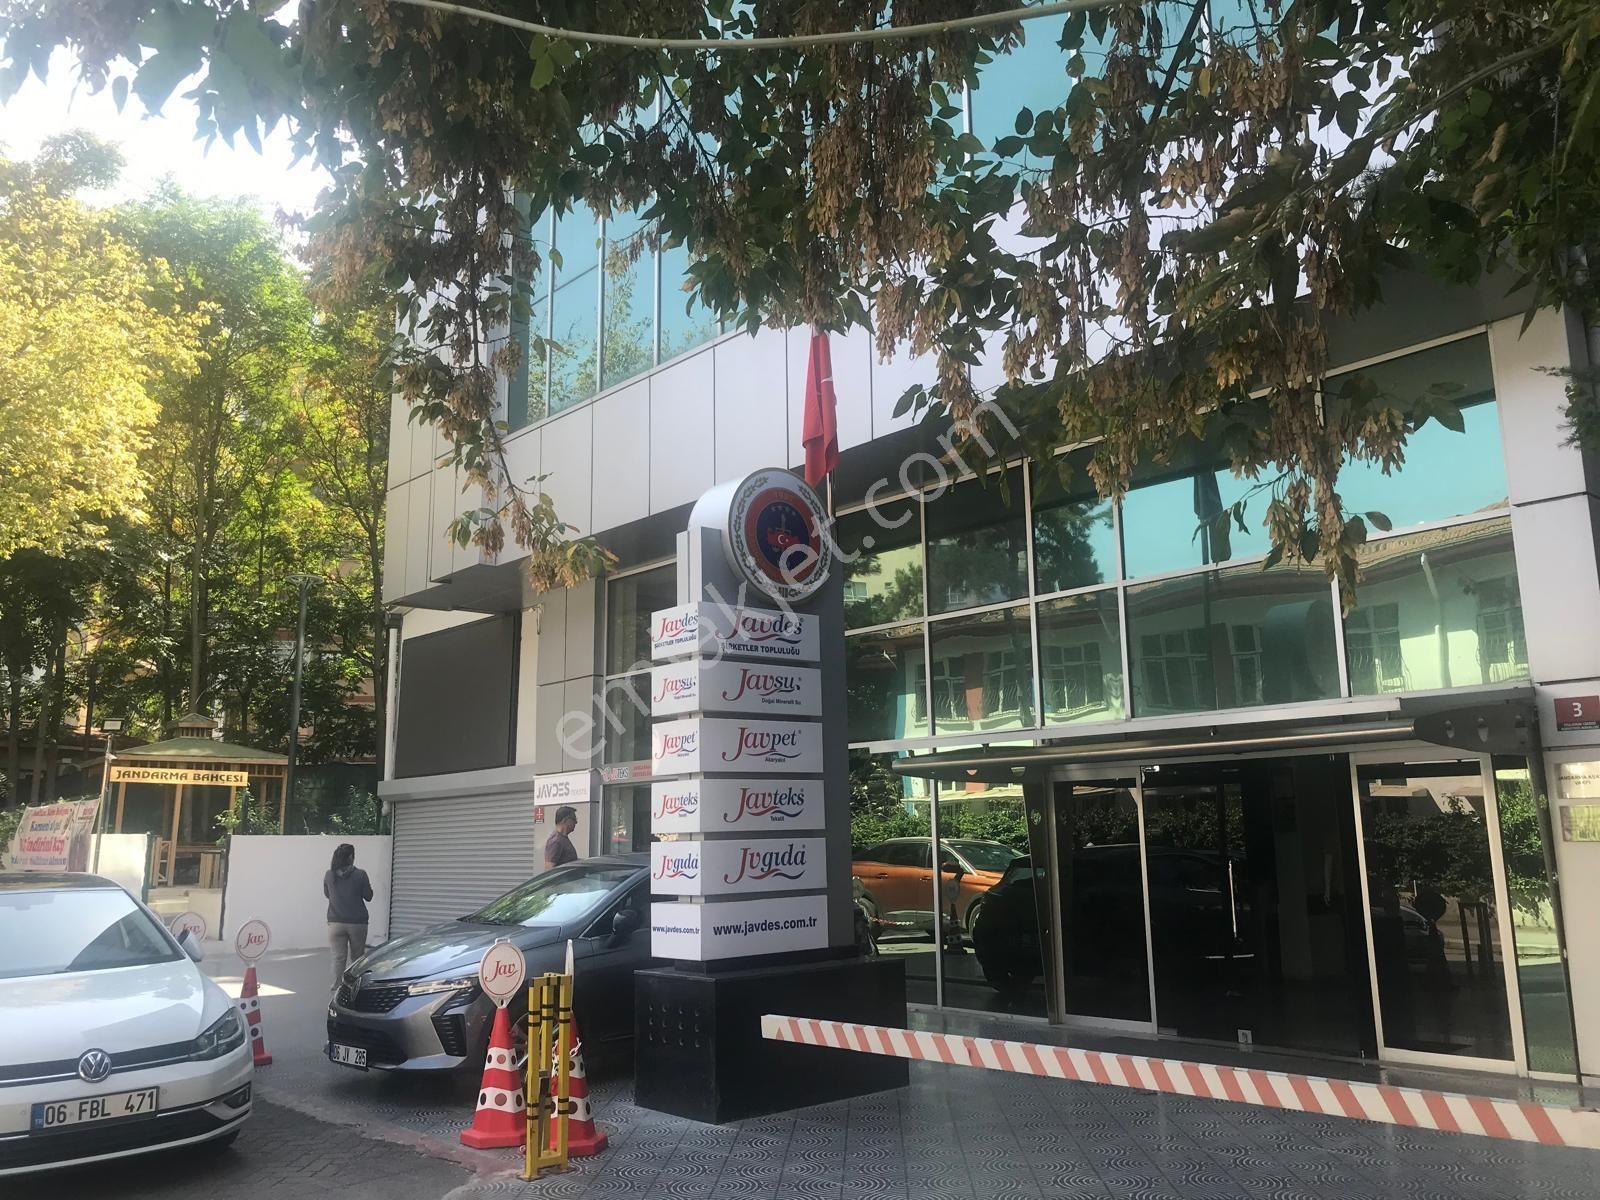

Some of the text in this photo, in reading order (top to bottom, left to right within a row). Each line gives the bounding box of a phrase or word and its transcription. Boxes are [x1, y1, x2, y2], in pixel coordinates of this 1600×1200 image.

[652, 612, 698, 642] Javdes
[715, 609, 802, 640] Javdes
[761, 645, 800, 656] TOPLULUĞU
[722, 668, 795, 701] Javsu
[1572, 702, 1583, 717] 3
[655, 732, 695, 759] Javpet
[722, 727, 797, 761] Javpet
[116, 770, 188, 780] JANDARMA
[537, 782, 570, 799] JAVDES
[653, 792, 698, 819] Javteks
[723, 787, 804, 823] Javteks
[652, 925, 700, 934] www.javdes.com.tr
[713, 916, 817, 936] www.javdes.com.tr
[239, 933, 264, 950] Jav
[485, 961, 518, 982] Jav
[45, 1091, 154, 1125] 06 FBL 471
